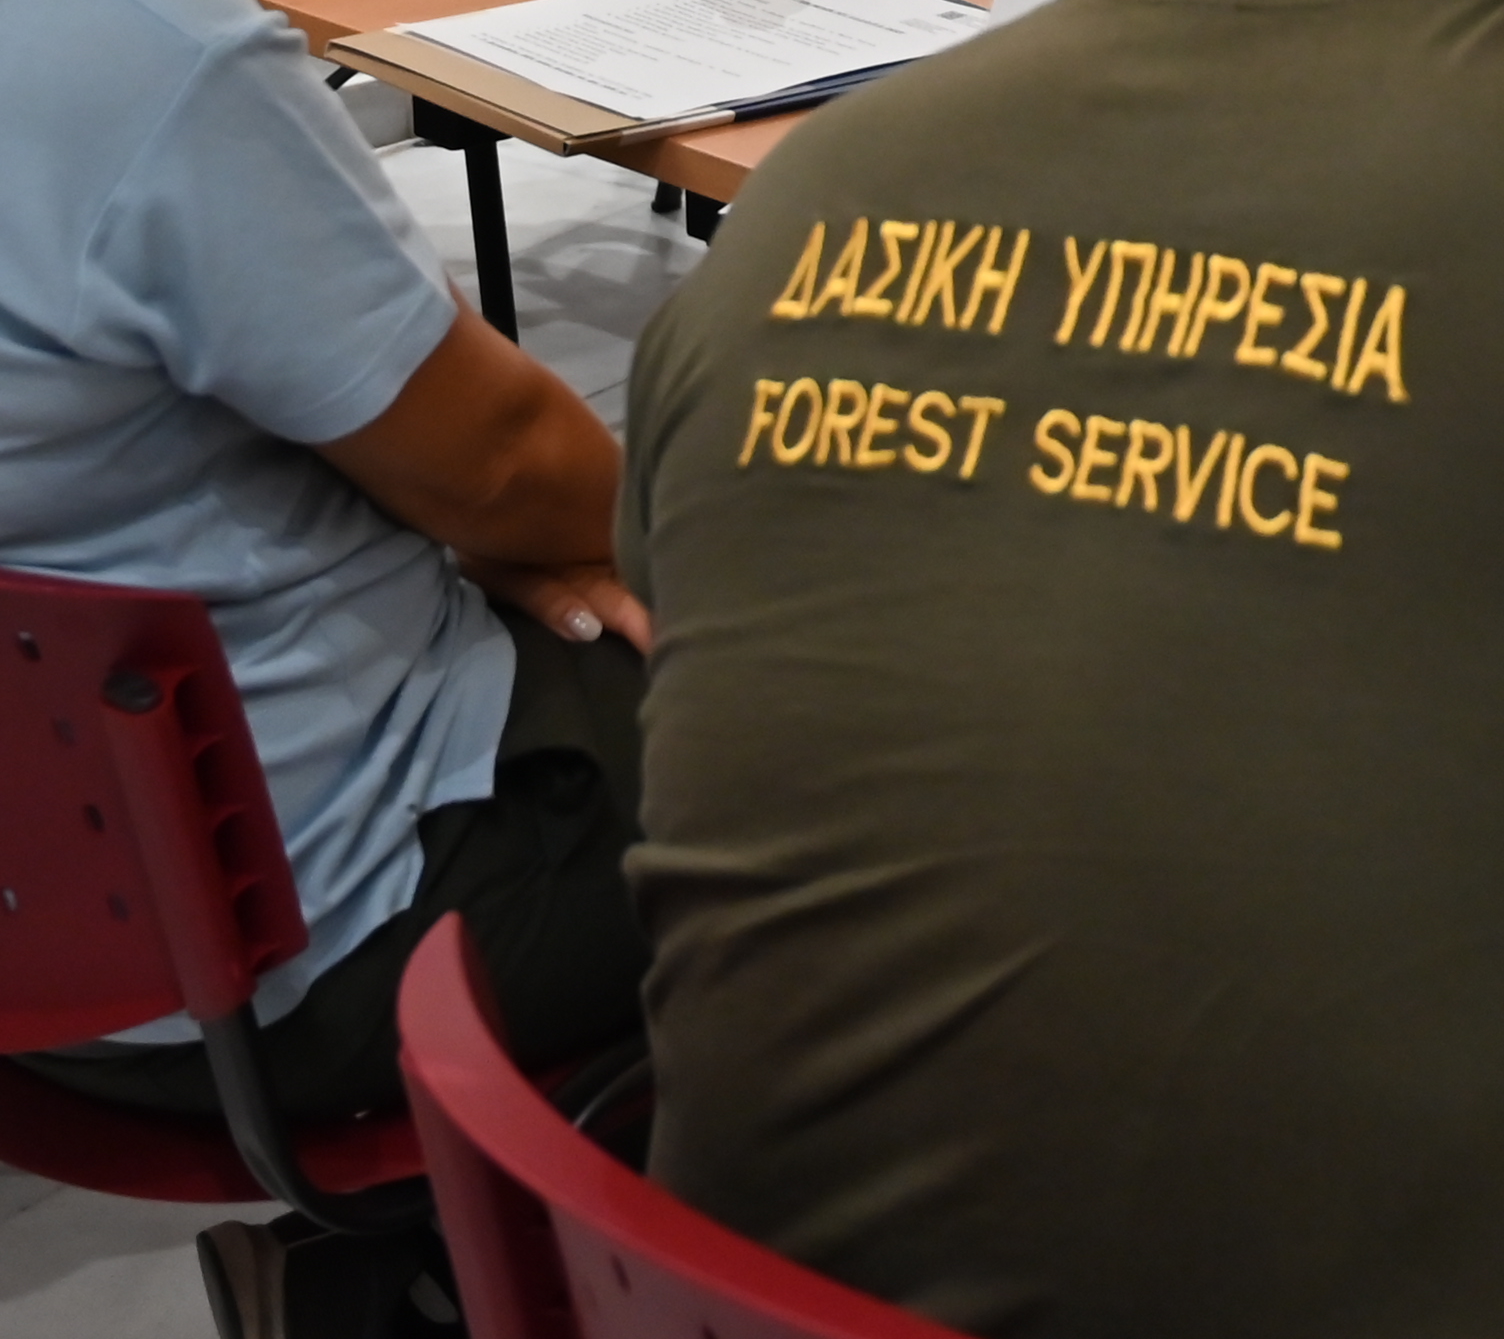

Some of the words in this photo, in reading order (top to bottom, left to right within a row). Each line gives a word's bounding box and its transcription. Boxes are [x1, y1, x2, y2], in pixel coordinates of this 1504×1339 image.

[772, 217, 1031, 335] ΔΑΣΙΚΗ
[1055, 236, 1410, 403] ΥΠΗΡΕΣΙΑ
[738, 377, 1006, 480] FOREST
[1028, 408, 1351, 550] SERVICE
